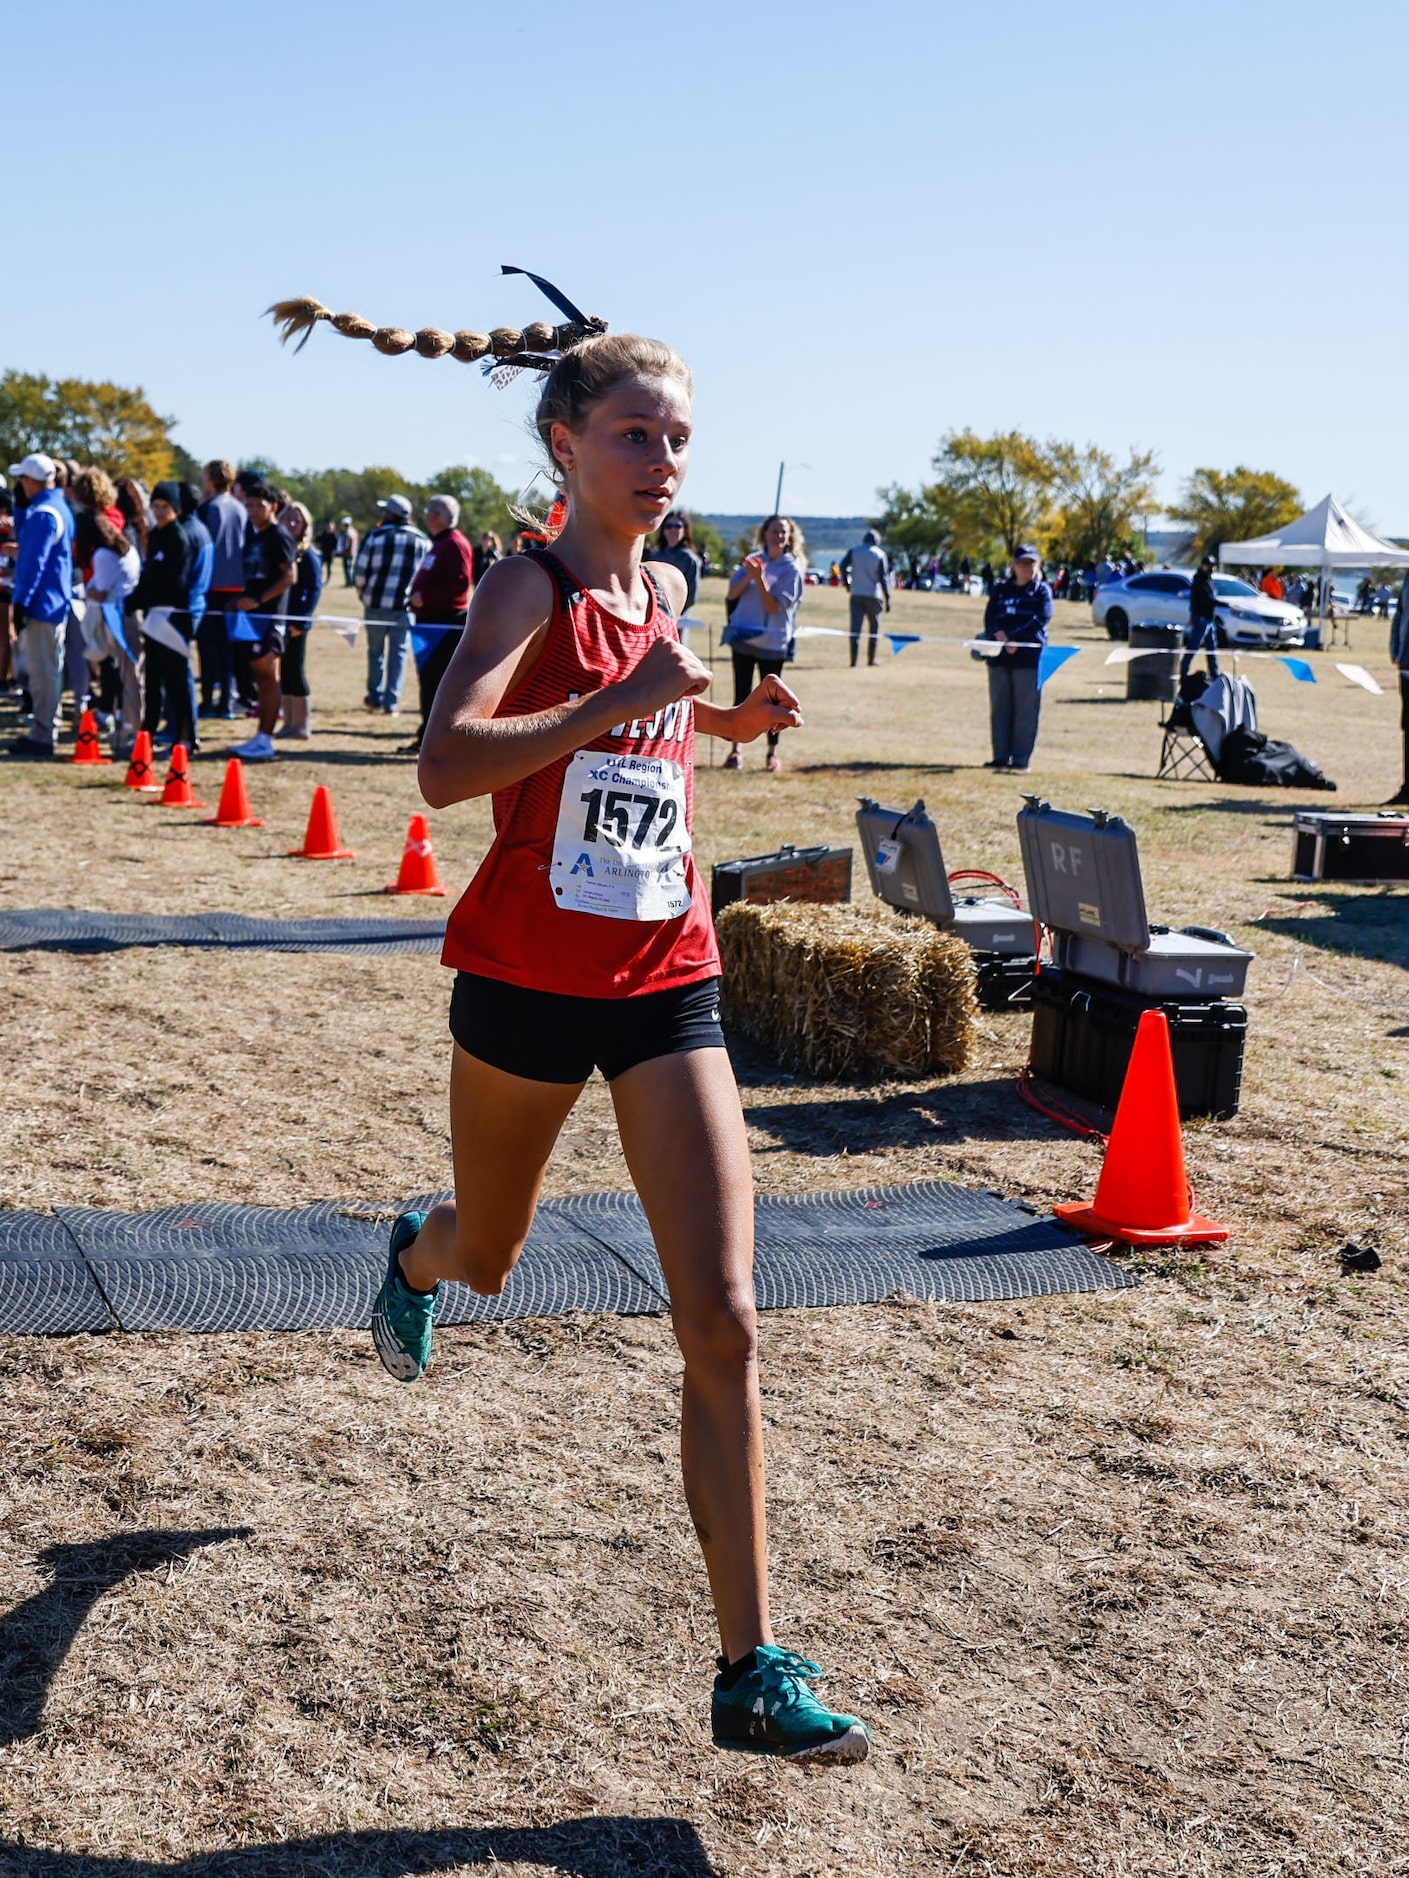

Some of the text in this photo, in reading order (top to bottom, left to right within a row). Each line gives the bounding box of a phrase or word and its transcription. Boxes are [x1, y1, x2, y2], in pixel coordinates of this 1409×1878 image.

[589, 769, 609, 781] XC
[629, 759, 663, 775] Region
[580, 788, 682, 851] 1572
[1050, 842, 1082, 876] RF
[666, 899, 683, 909] 1572
